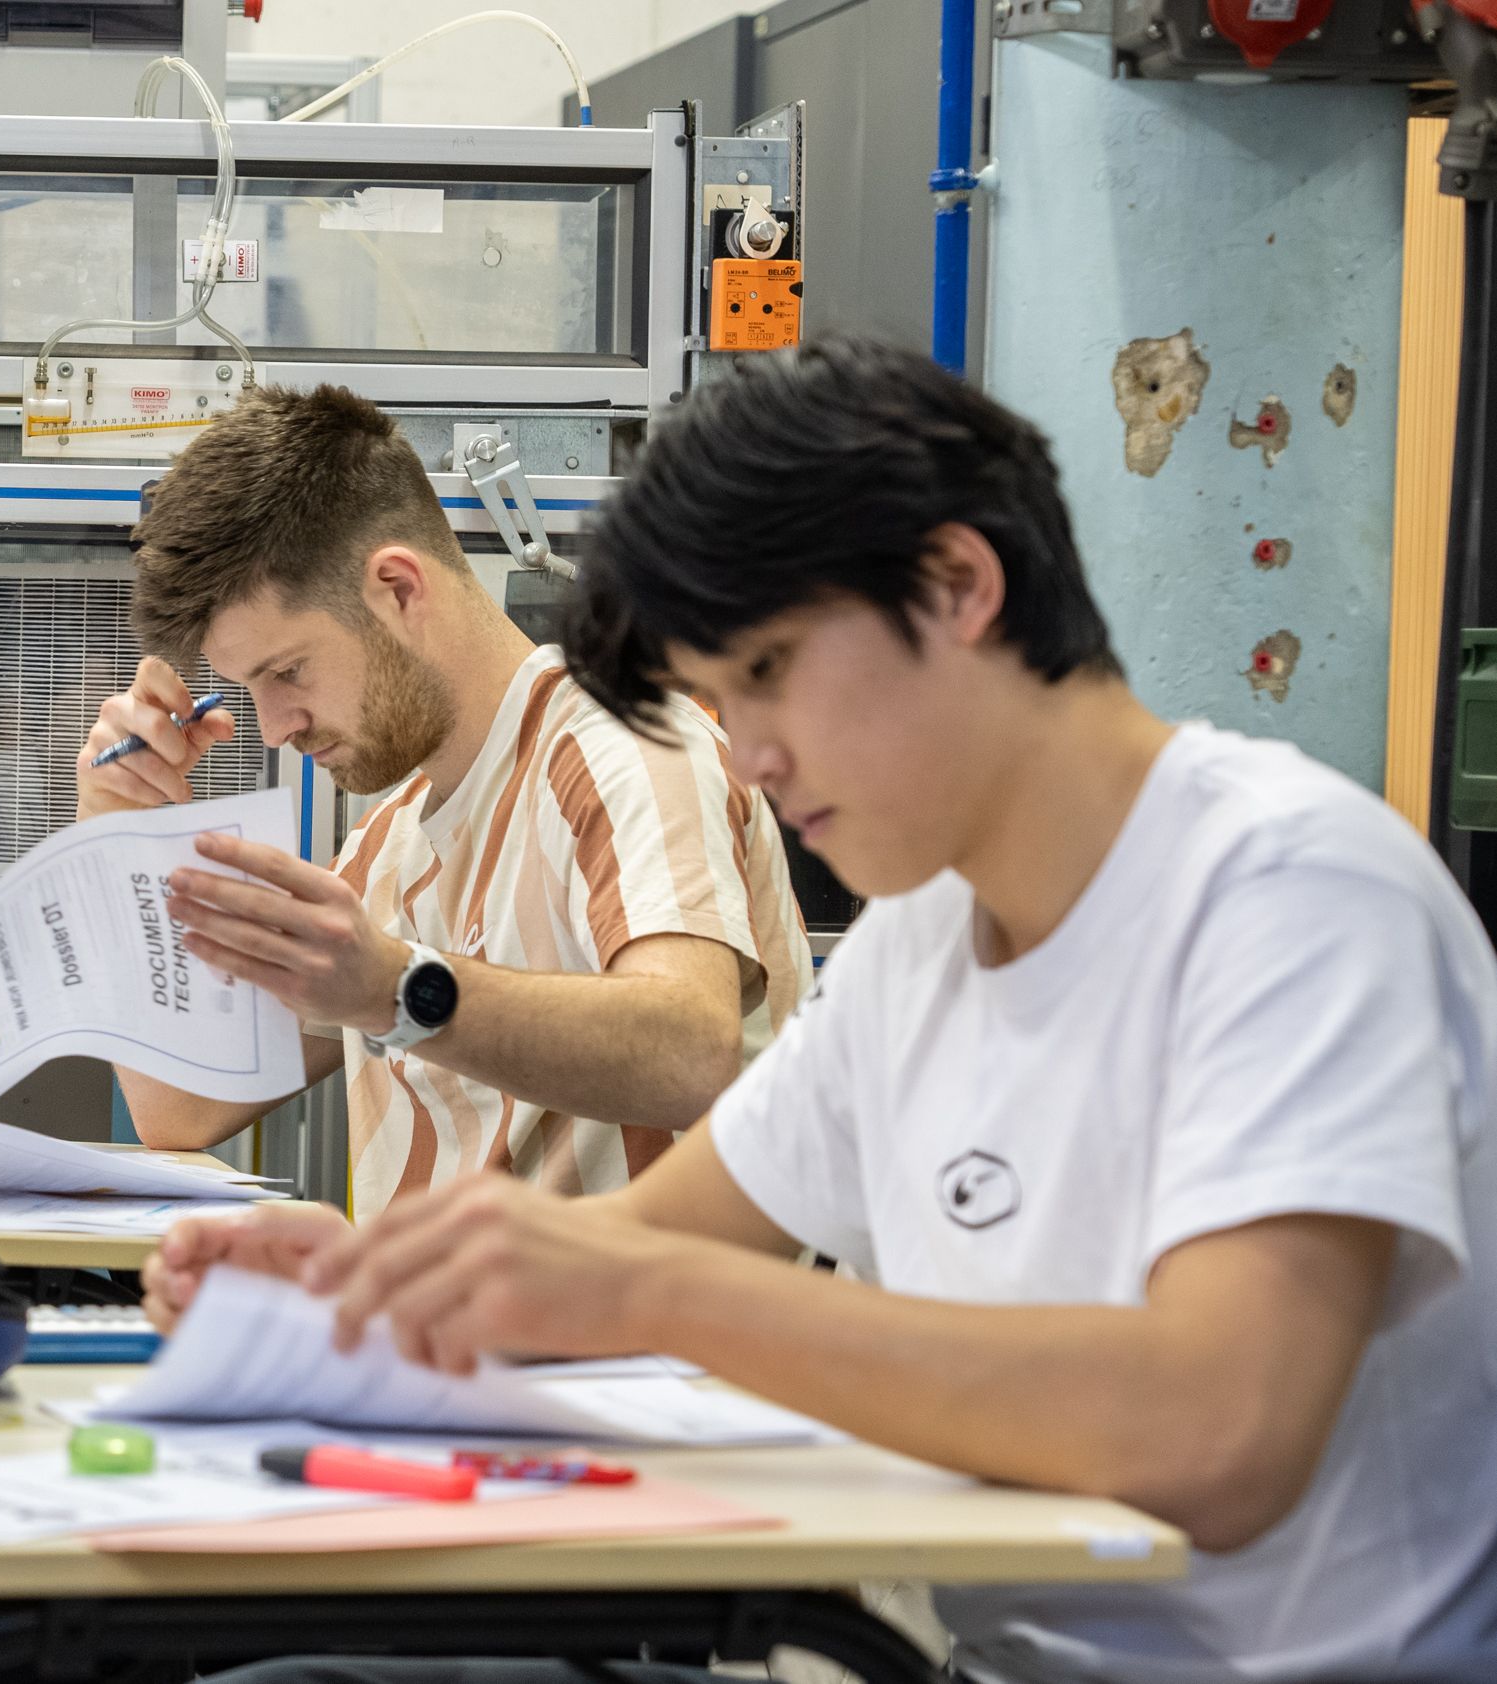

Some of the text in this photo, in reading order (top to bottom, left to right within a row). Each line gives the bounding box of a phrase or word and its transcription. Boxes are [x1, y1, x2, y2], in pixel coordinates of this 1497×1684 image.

[237, 247, 245, 276] KIMO
[767, 267, 797, 277] BELIMO
[134, 390, 165, 398] KIMO
[40, 901, 82, 988] Dossier DT
[131, 871, 168, 1008] DOCUMENTS
